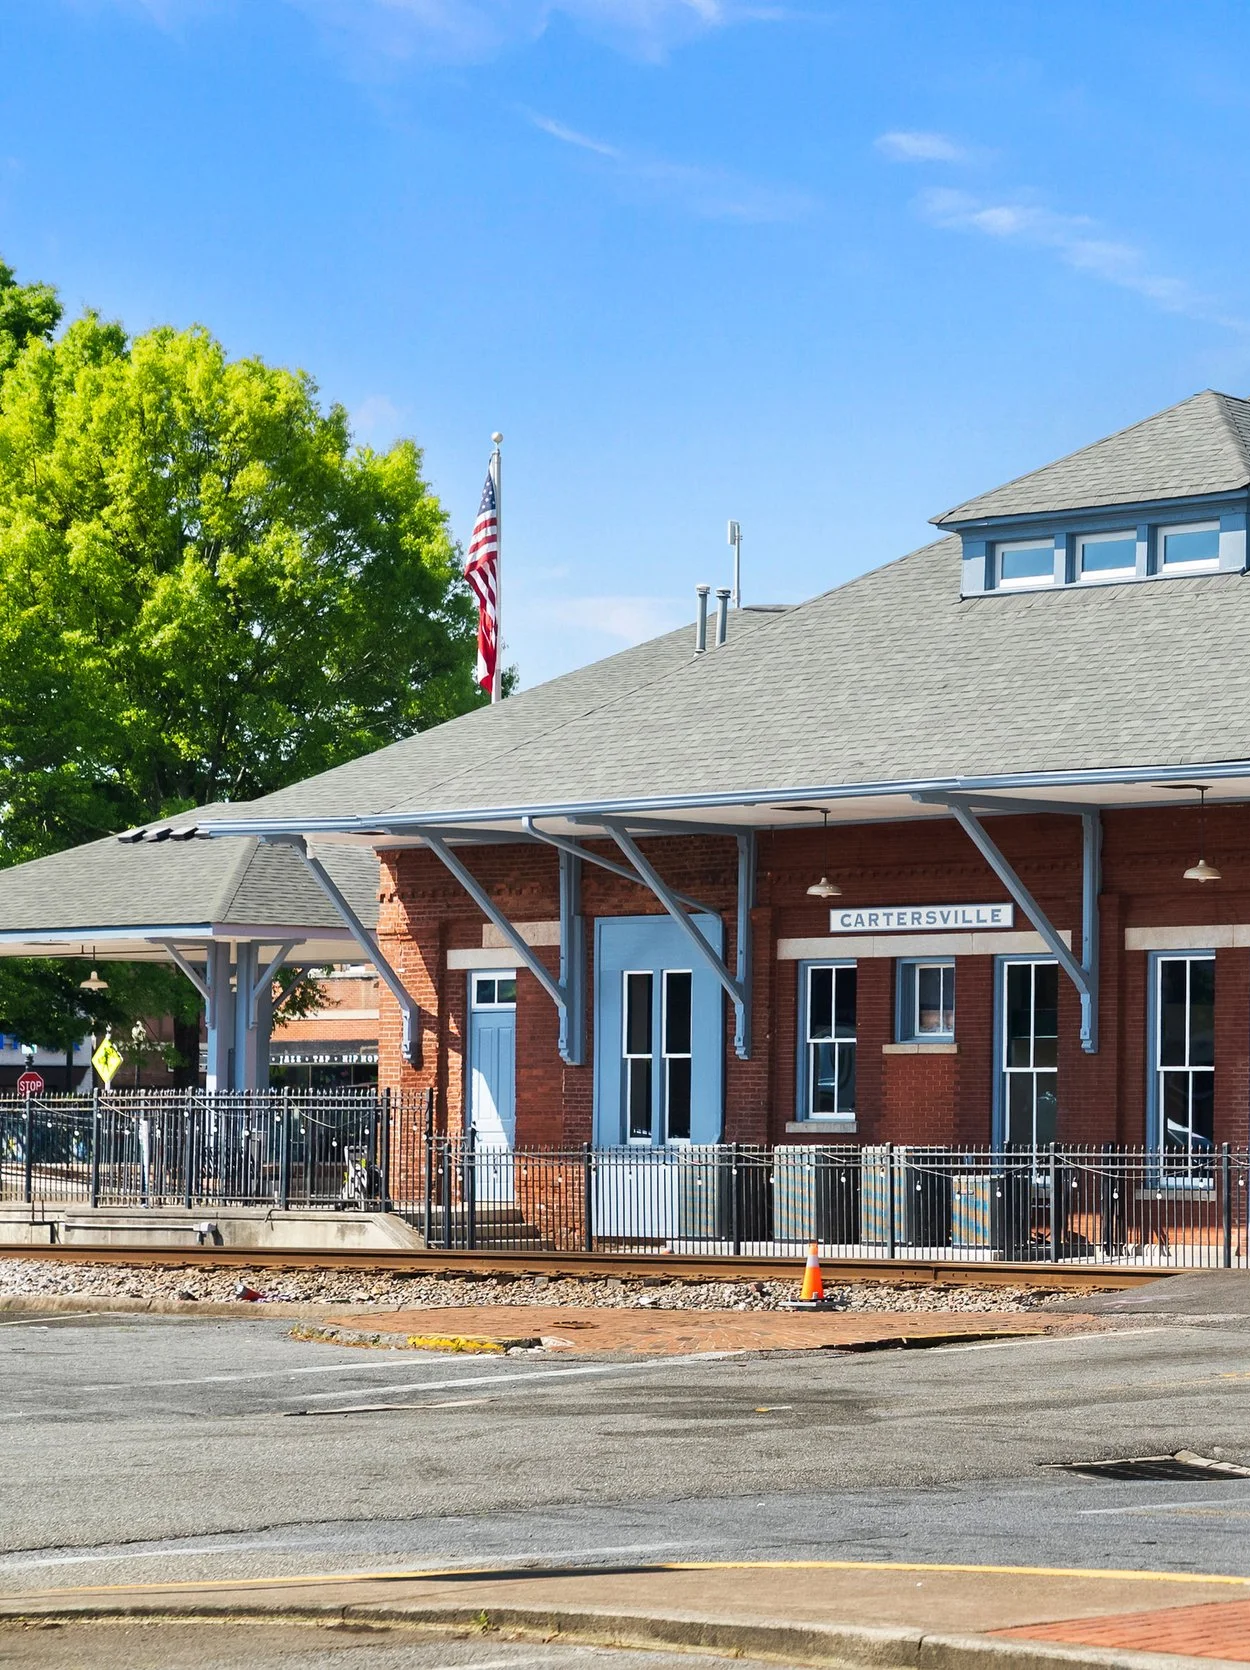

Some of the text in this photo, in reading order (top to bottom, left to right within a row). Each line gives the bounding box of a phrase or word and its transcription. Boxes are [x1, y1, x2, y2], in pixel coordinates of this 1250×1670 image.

[840, 908, 1002, 927] CARTERSVILLE
[280, 1054, 379, 1064] JAZZ TAP HIP HOP
[20, 1081, 42, 1091] STOP
